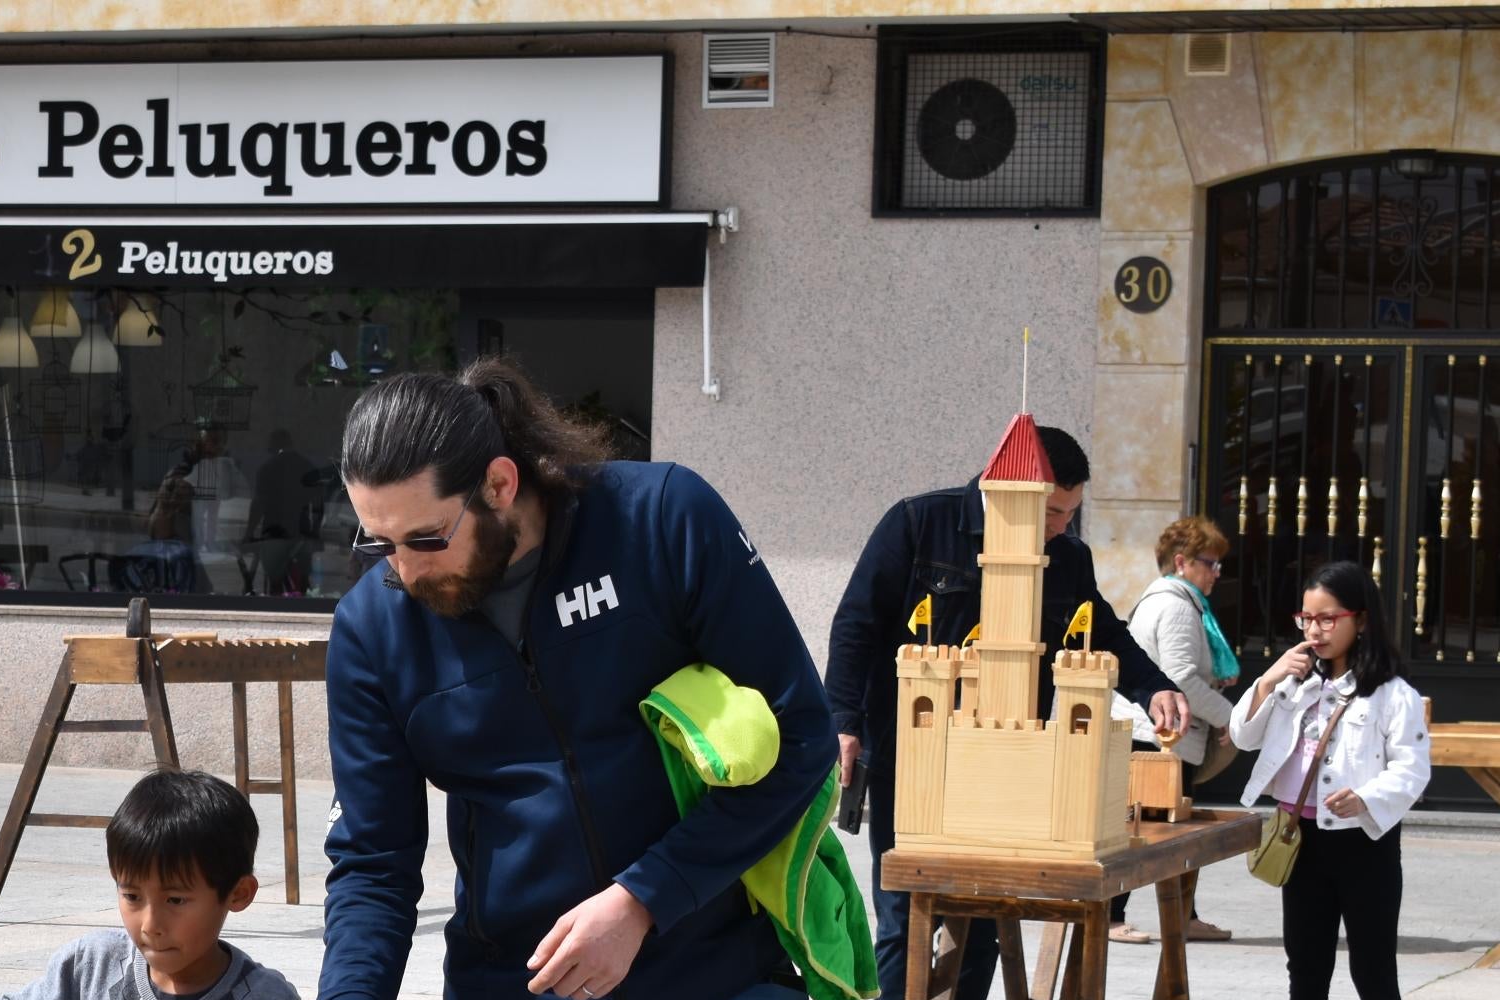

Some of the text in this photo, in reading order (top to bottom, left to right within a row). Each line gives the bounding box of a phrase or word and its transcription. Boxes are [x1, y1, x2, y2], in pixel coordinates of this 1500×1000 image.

[37, 98, 549, 197] Peluqueros
[62, 228, 102, 281] 2
[117, 241, 334, 282] Peluqueros
[1120, 266, 1169, 304] 30
[555, 574, 620, 628] HH
